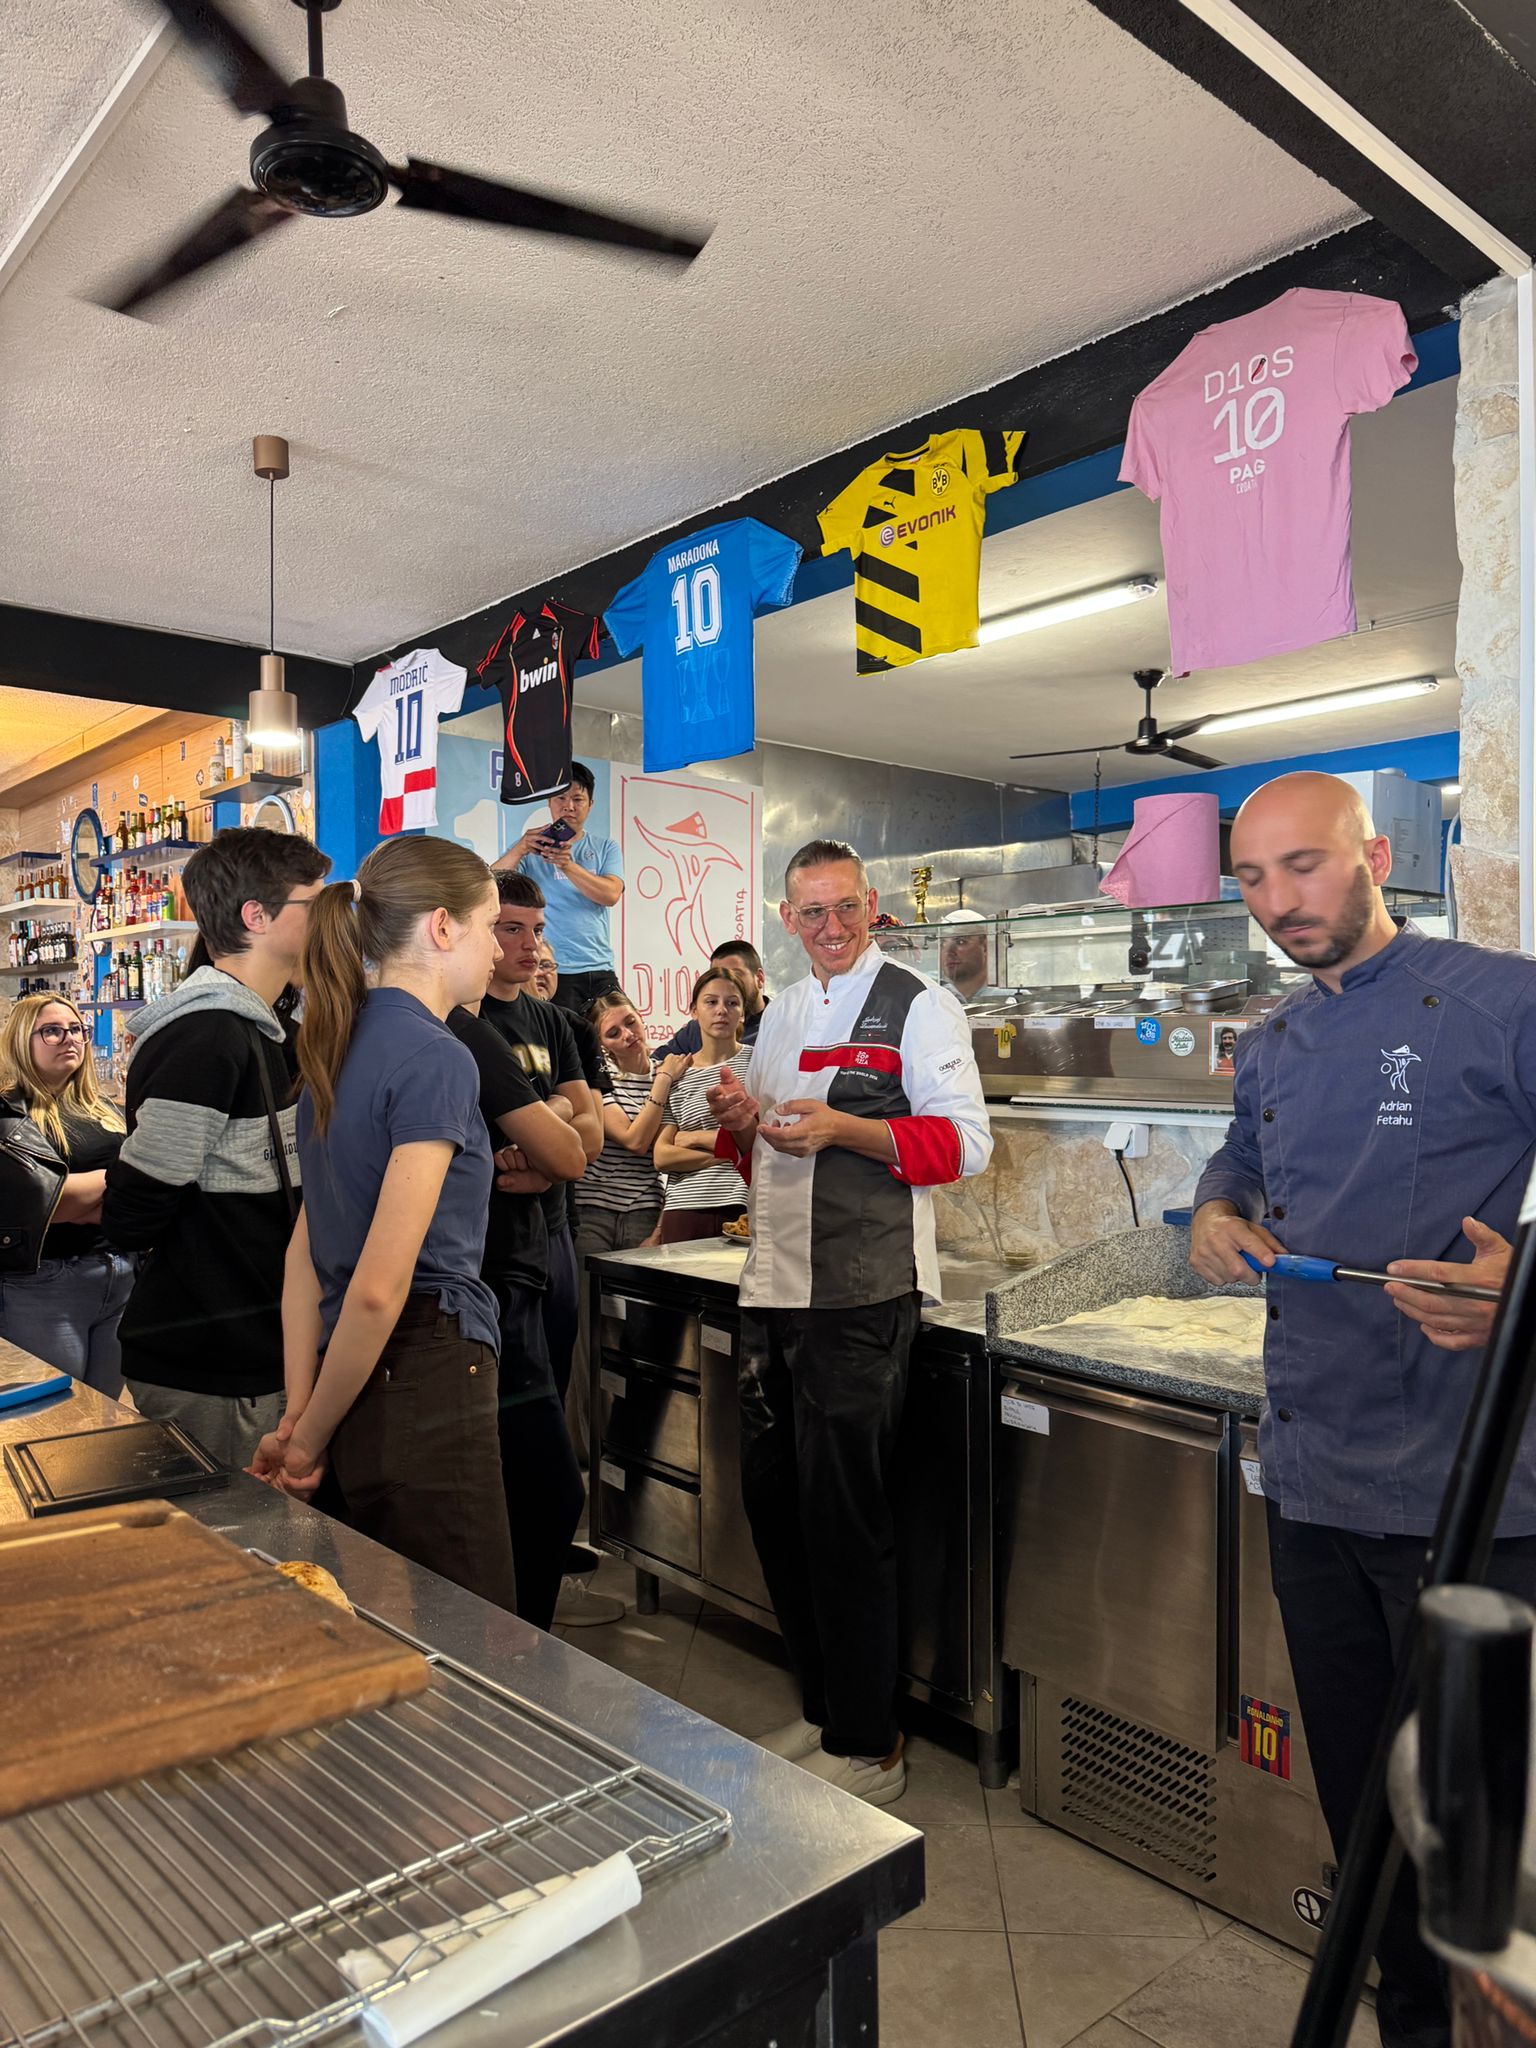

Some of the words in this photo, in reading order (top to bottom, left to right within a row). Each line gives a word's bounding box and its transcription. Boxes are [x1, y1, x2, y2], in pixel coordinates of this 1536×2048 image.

[1204, 345, 1294, 404] D10S
[1213, 386, 1285, 464] 10
[932, 471, 947, 489] BVB
[1230, 458, 1266, 484] PAG
[896, 504, 957, 539] EVONIK
[667, 538, 720, 575] MARADONA
[671, 562, 723, 656] 10
[389, 662, 429, 697] MODRIĆ
[519, 656, 559, 694] bwin
[394, 689, 424, 766] 10
[734, 888, 748, 941] ROATIA
[632, 963, 700, 1017] D10
[646, 1024, 675, 1041] IZZA
[1001, 1029, 1010, 1043] 10
[1376, 1114, 1413, 1126] Fetahu
[1379, 1100, 1412, 1112] Adrian
[1254, 1722, 1277, 1761] 10
